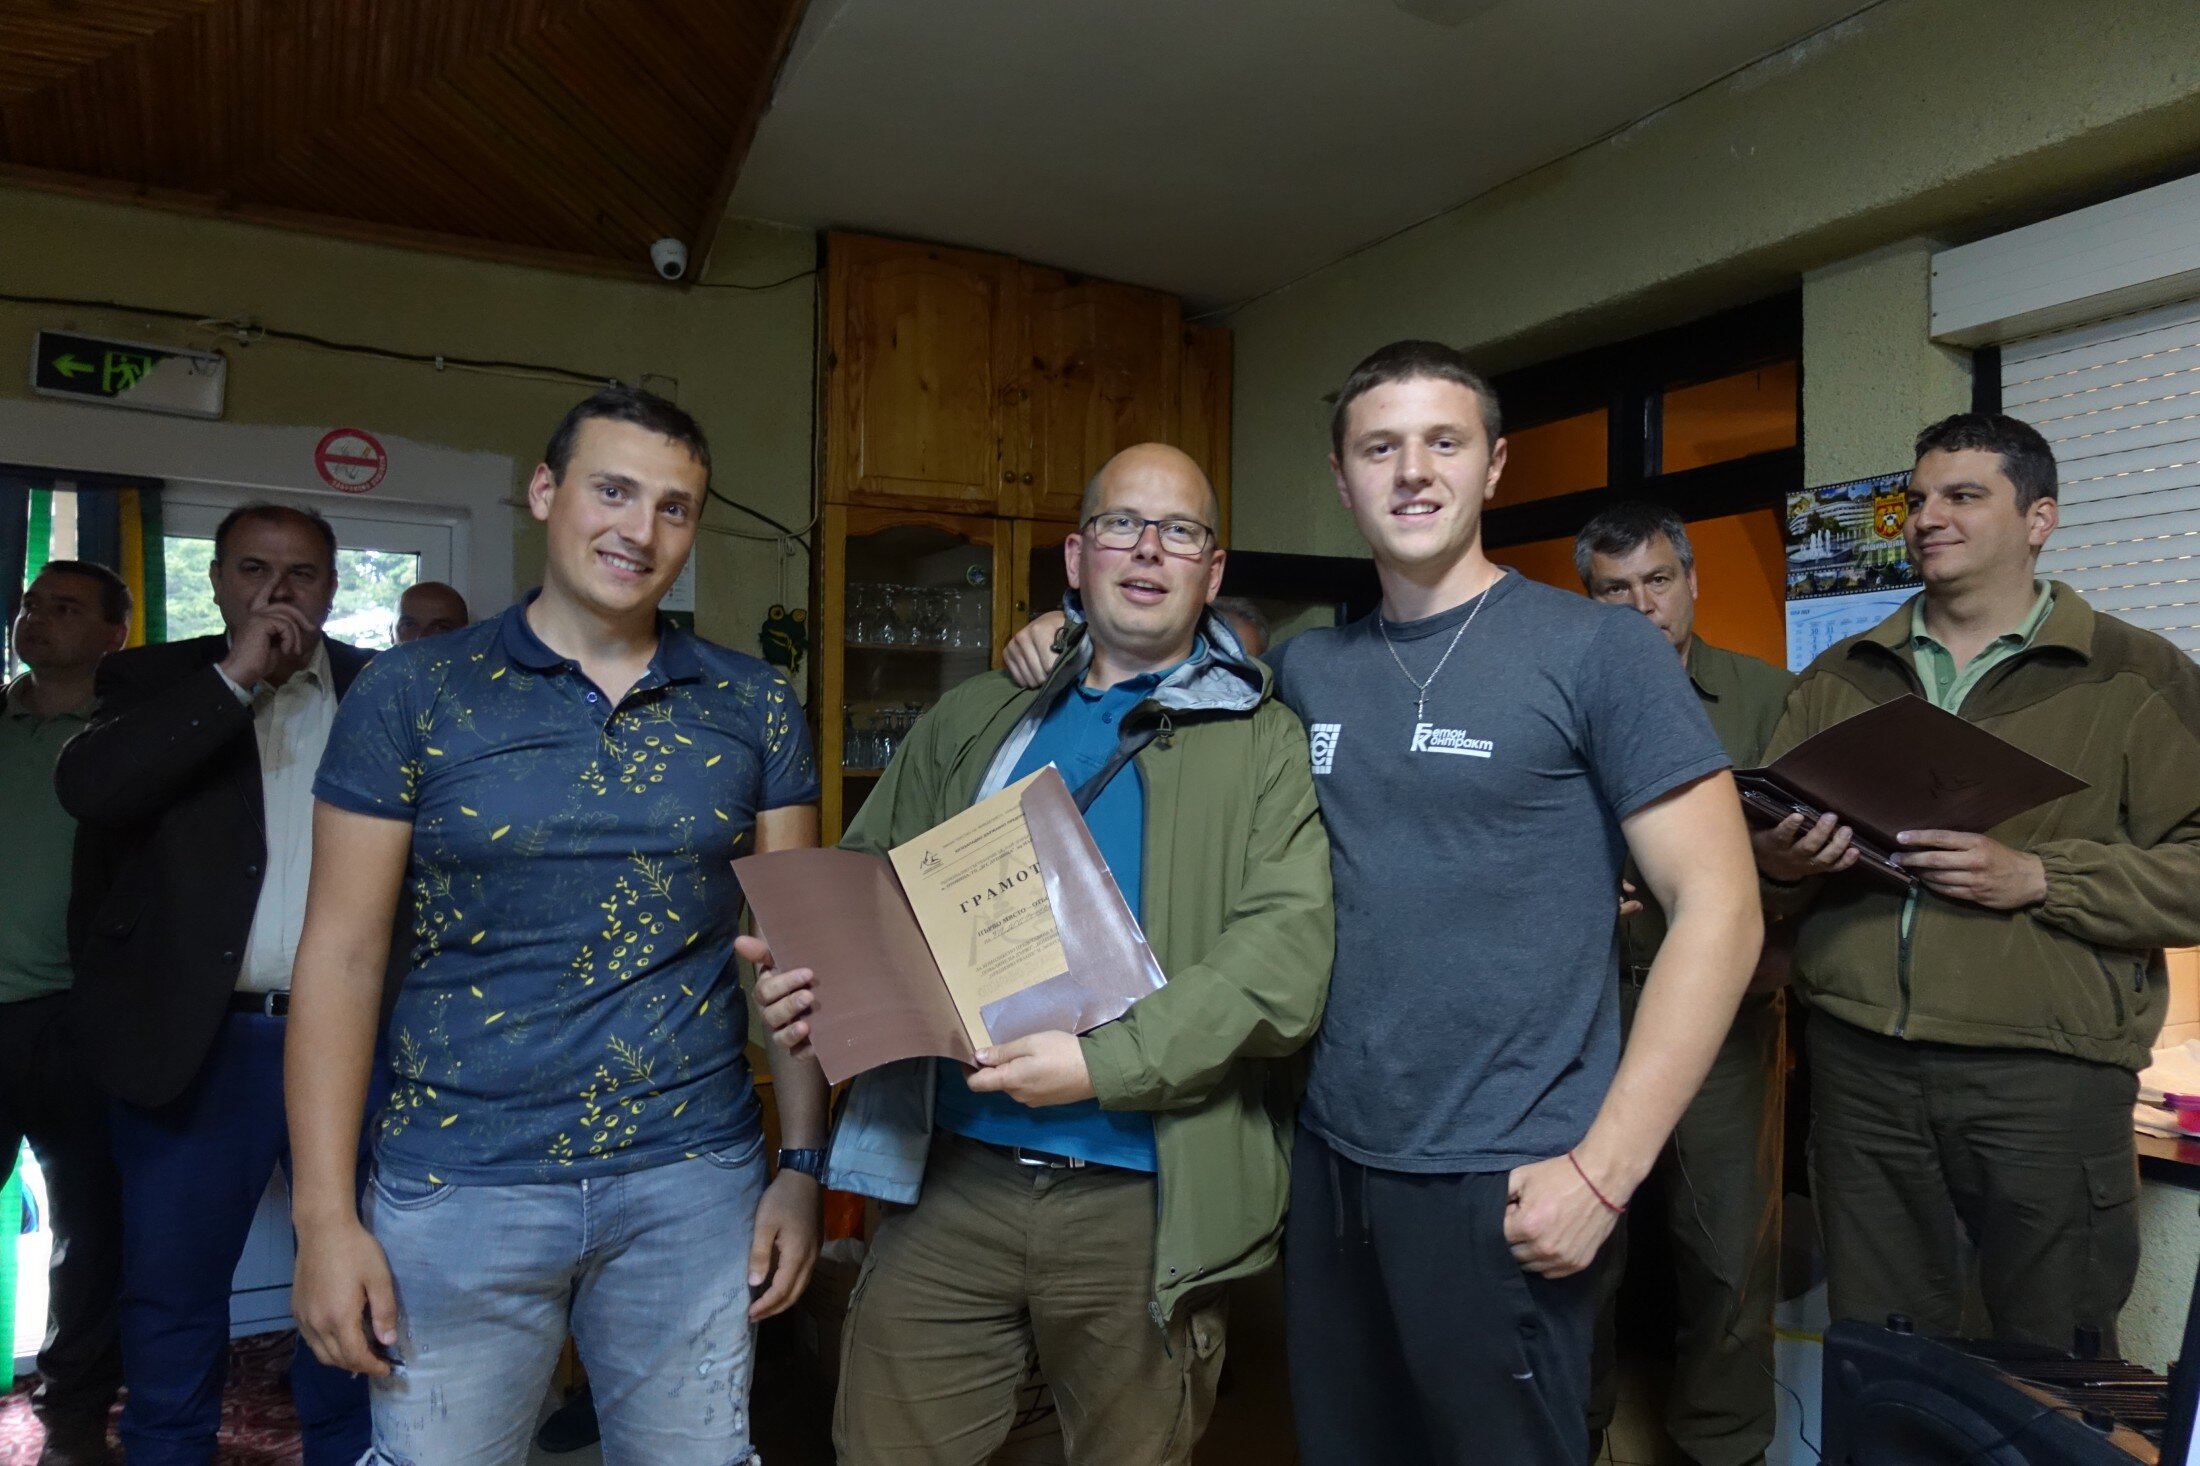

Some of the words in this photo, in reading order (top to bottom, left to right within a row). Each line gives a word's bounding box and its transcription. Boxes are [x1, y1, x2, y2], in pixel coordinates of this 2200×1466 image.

[1413, 723, 1467, 738] Бетон
[1410, 734, 1493, 751] Контракт
[977, 921, 1002, 937] ПЪРВО
[1002, 907, 1027, 924] МЯСТО
